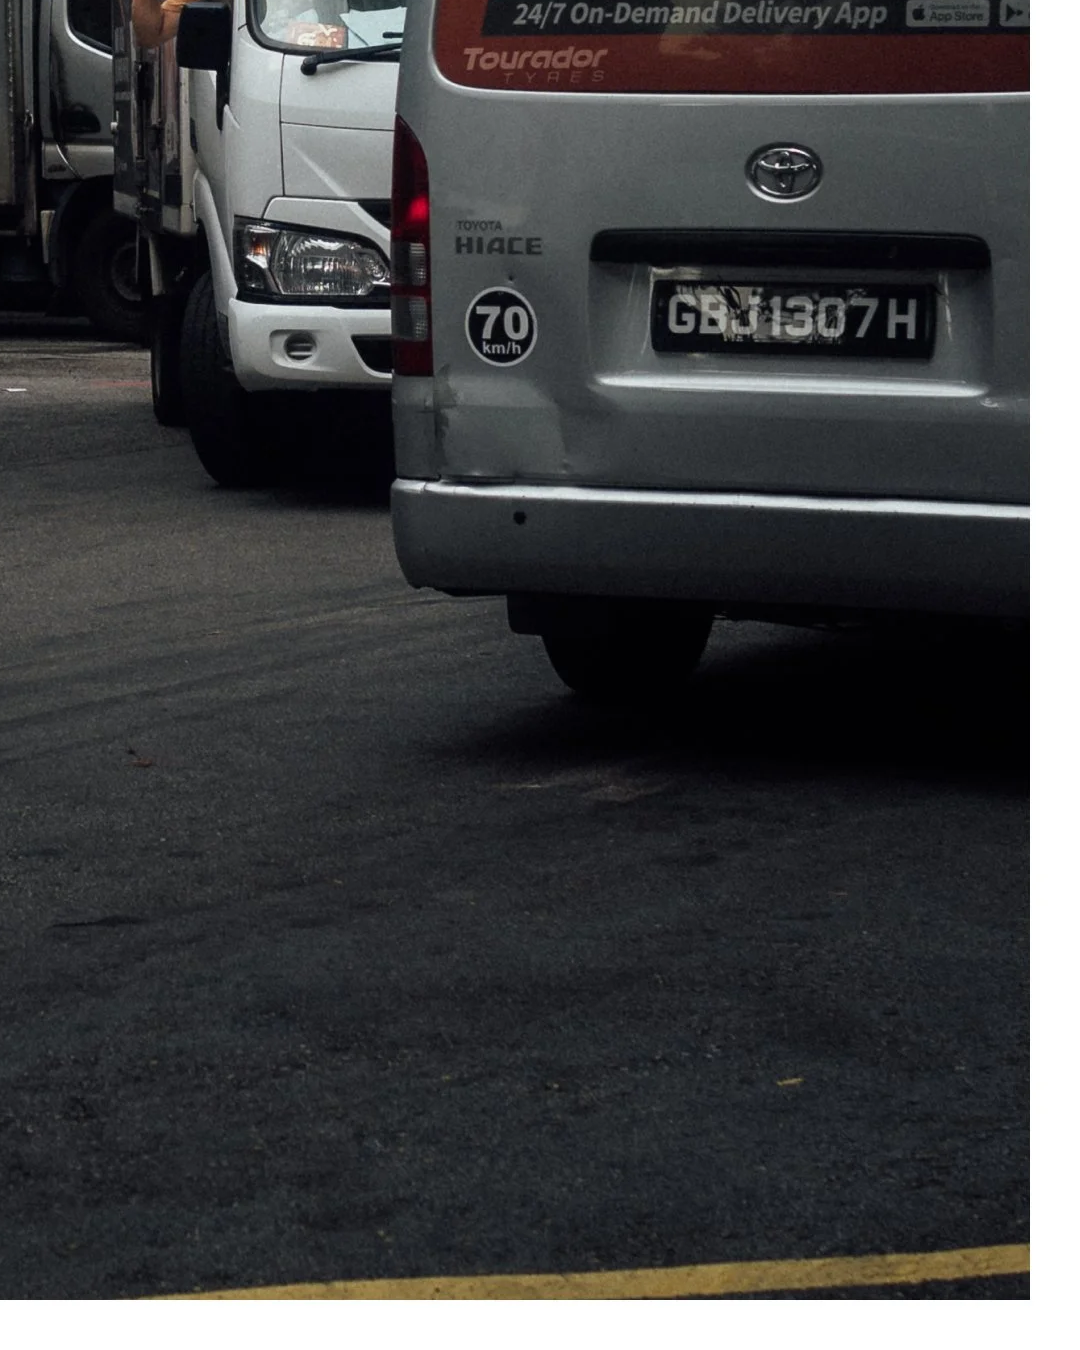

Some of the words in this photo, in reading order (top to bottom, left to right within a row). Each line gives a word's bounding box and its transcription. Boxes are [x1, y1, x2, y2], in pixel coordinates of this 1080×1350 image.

[512, 1, 568, 29] 24/7
[570, 0, 718, 26] On-Demand
[724, 0, 831, 30] Delivery
[833, 0, 888, 29] App
[929, 11, 953, 23] App
[954, 11, 984, 22] Store
[462, 45, 609, 71] Tourador
[503, 69, 606, 84] TYRES
[456, 220, 503, 231] TOYOTA
[455, 236, 543, 256] HIACE
[475, 305, 529, 341] 70
[482, 340, 522, 355] km/h
